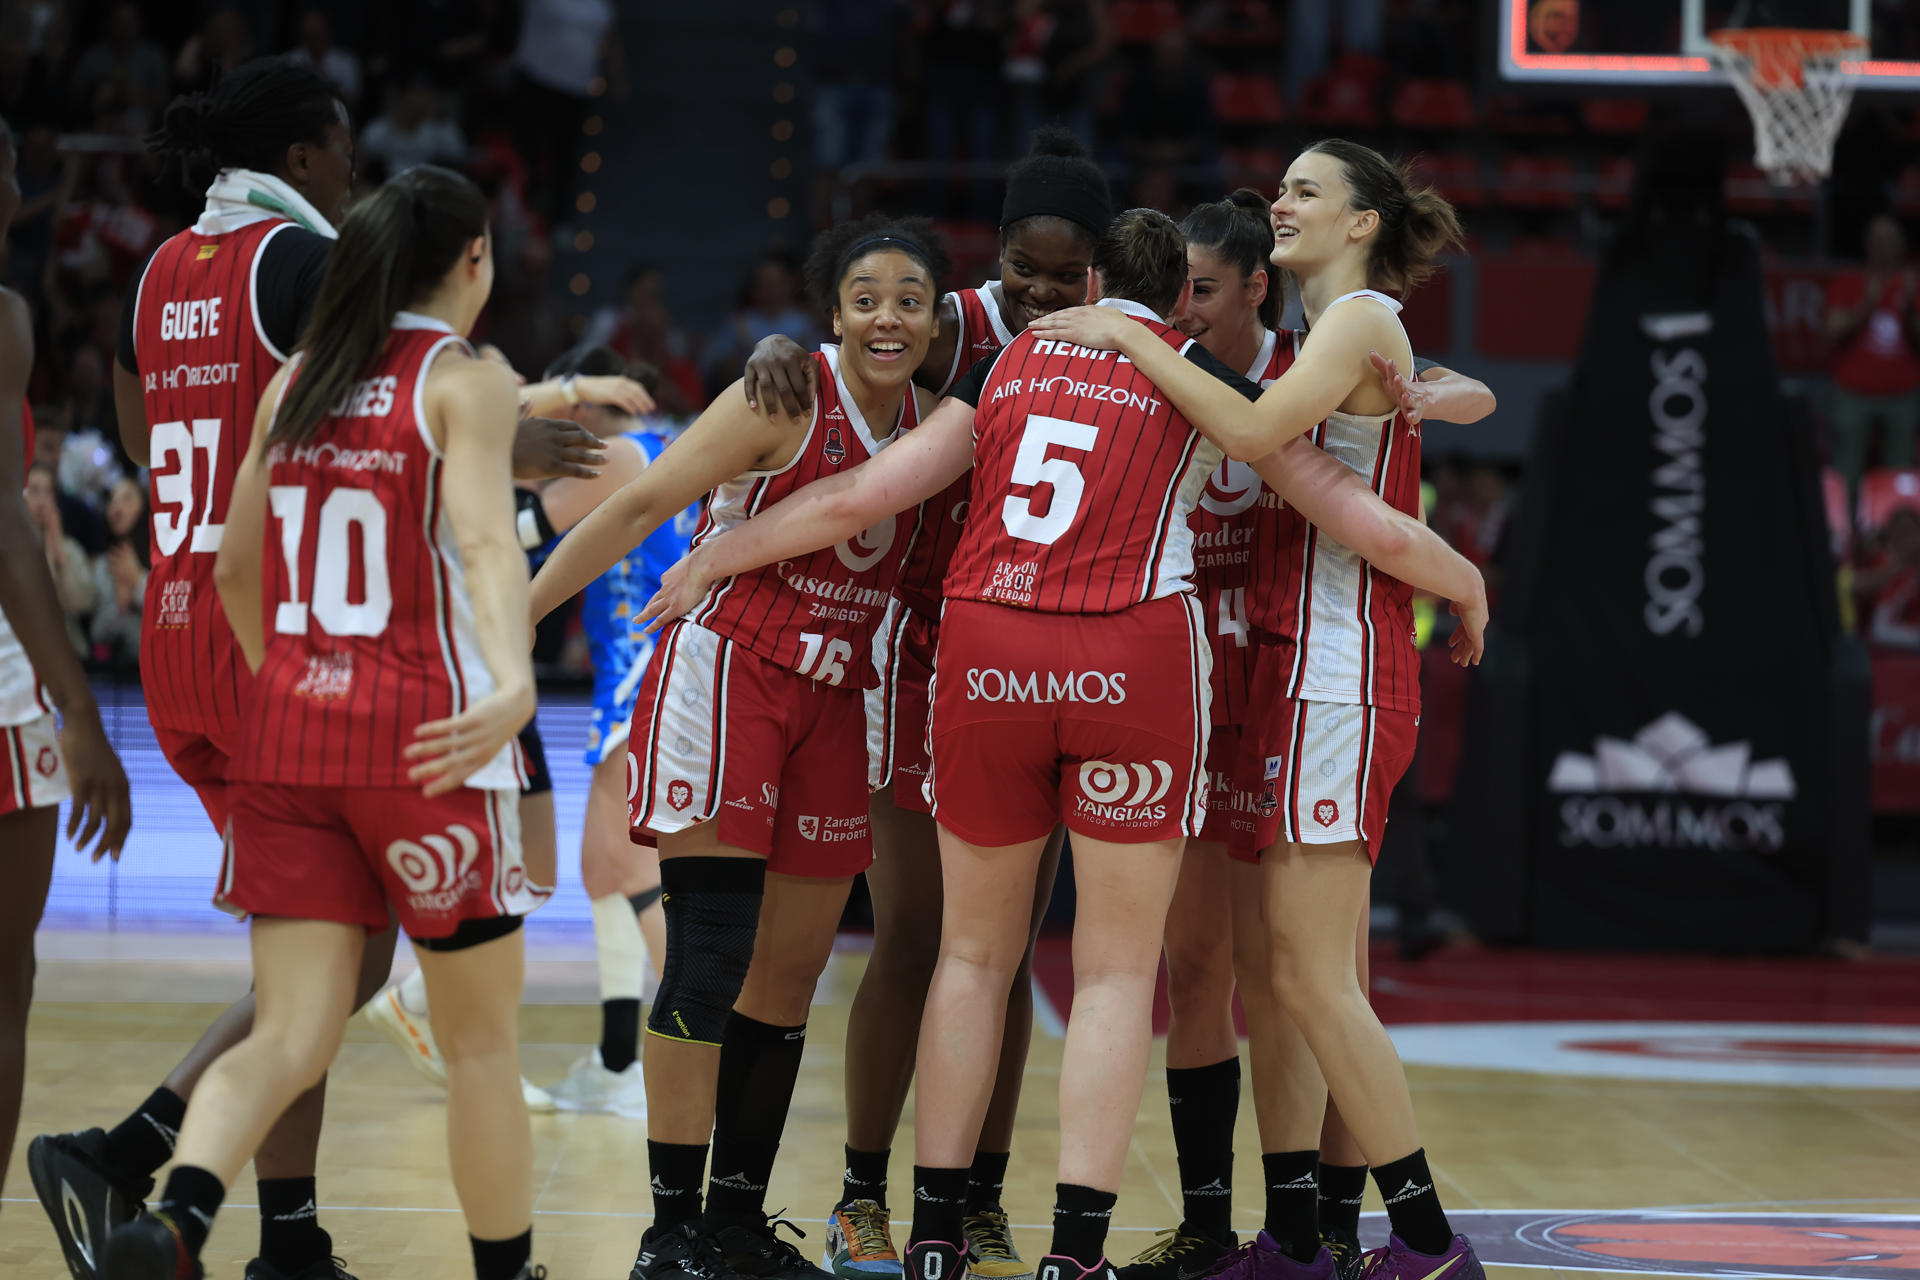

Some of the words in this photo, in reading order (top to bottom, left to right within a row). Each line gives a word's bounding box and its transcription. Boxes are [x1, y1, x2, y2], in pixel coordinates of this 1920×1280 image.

[160, 297, 222, 341] GUEYE
[991, 379, 1022, 404] AIR
[1028, 375, 1162, 416] HORIZONT
[150, 418, 226, 557] 31
[1001, 414, 1099, 546] 5
[1644, 348, 1708, 638] SOMMOS
[268, 485, 393, 638] 10
[996, 588, 1031, 602] VERDAD
[1218, 587, 1250, 648] 4
[795, 631, 853, 687] 16
[966, 668, 1126, 704] SOMMOS
[824, 814, 868, 829] Zaragoza
[1075, 795, 1167, 822] YANGUAS
[1559, 796, 1784, 853] SOMMOS
[711, 1175, 766, 1190] MERCURY
[1183, 1188, 1232, 1196] MERCURY
[1384, 1182, 1433, 1205] MERCURY
